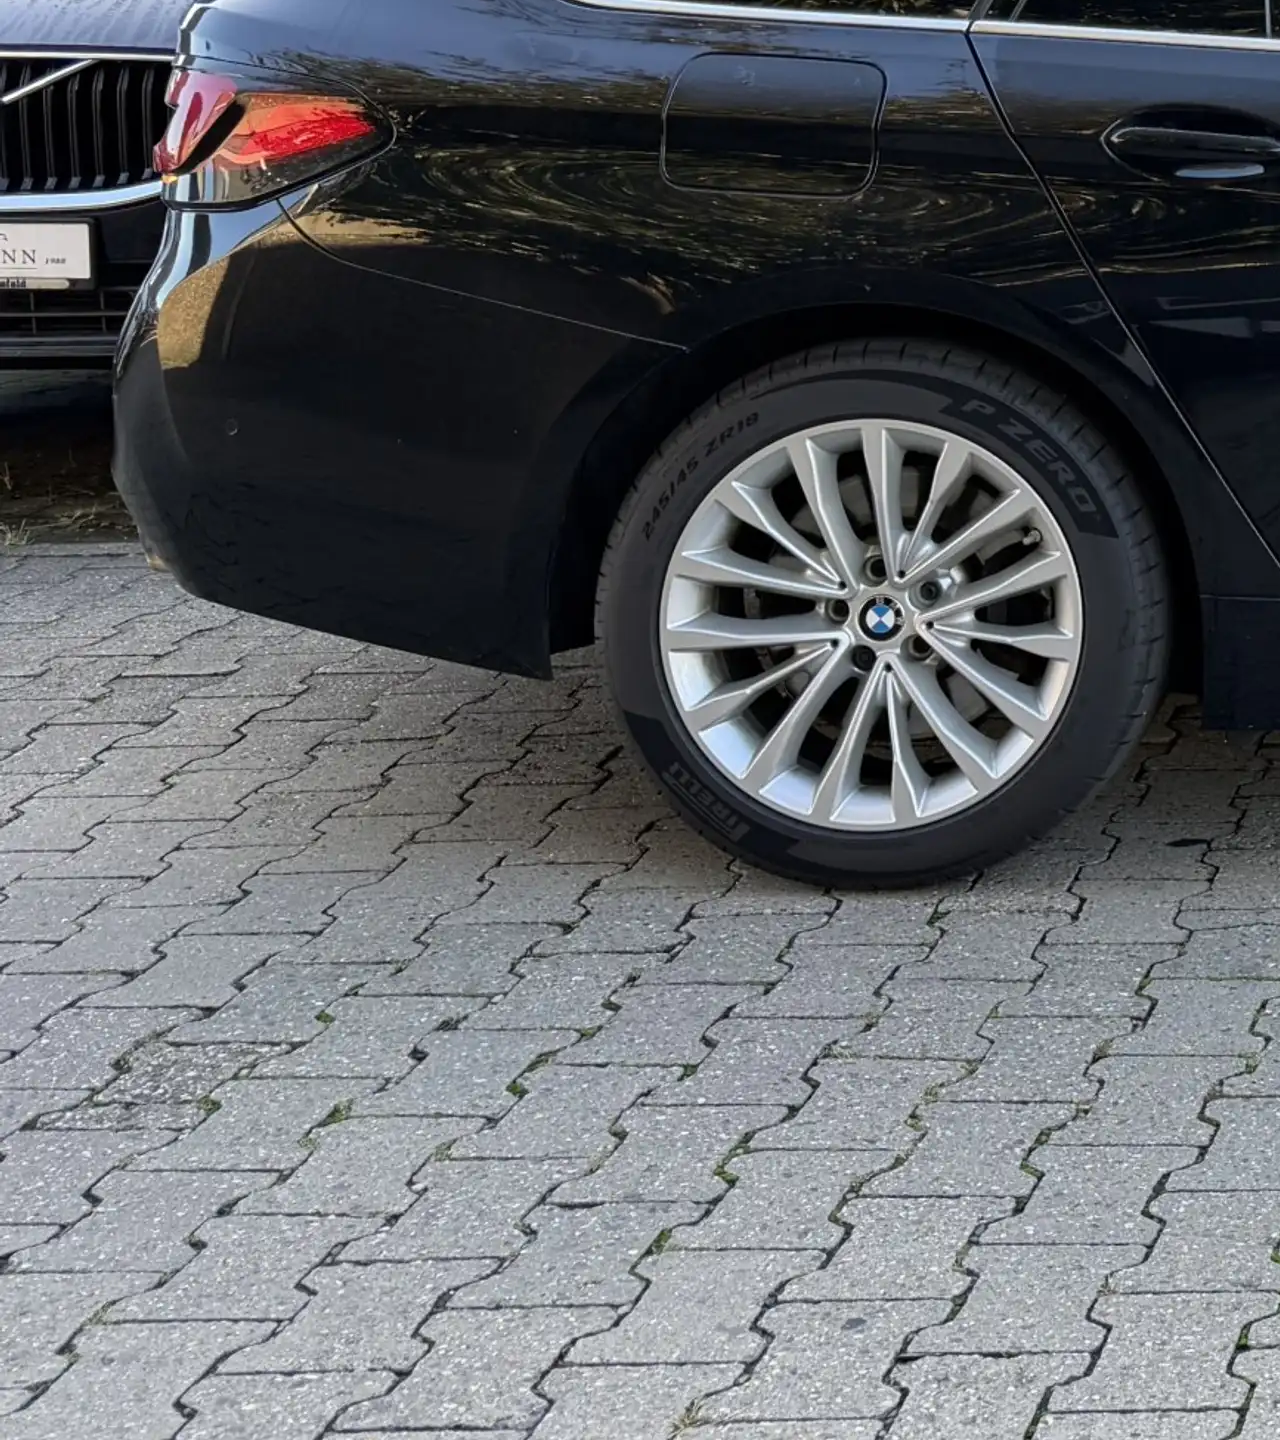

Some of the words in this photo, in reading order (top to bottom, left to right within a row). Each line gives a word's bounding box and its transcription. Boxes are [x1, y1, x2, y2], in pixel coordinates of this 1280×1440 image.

[642, 455, 699, 542] 245/45
[704, 412, 759, 458] ZR18
[996, 416, 1098, 513] ZERO
